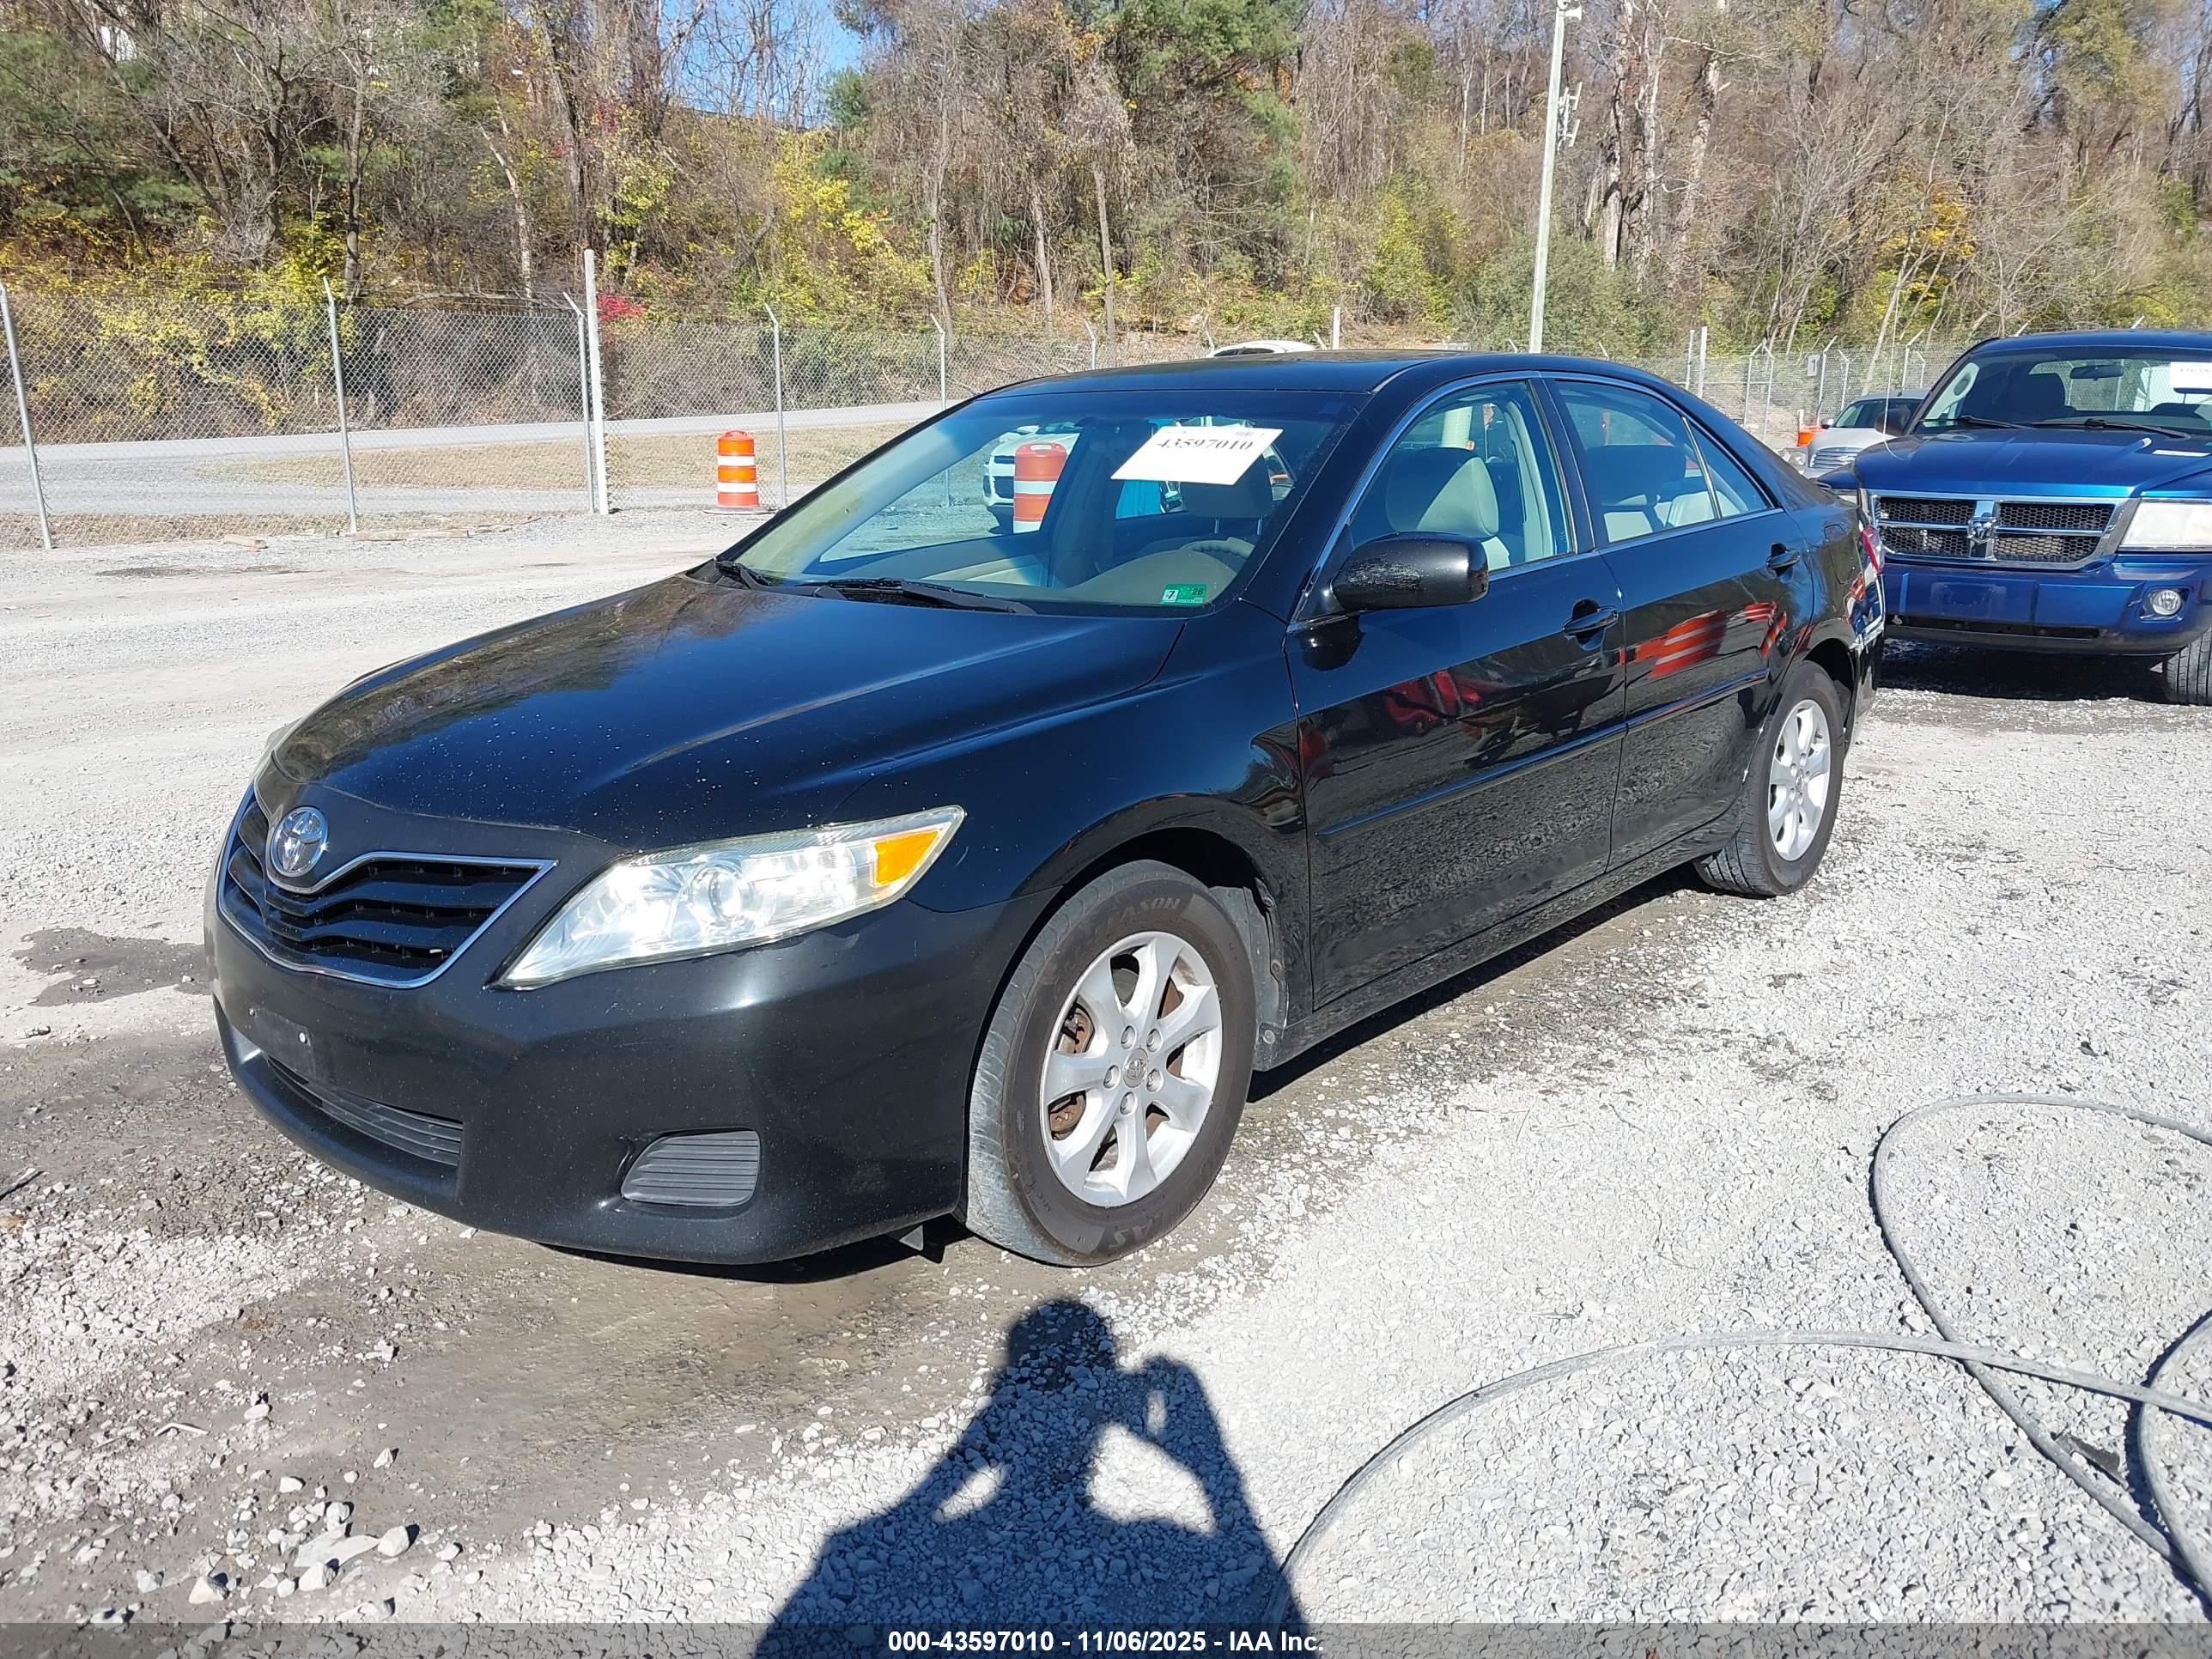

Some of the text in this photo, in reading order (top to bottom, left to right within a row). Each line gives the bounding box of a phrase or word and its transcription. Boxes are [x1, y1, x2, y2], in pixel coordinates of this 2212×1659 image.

[1157, 438, 1254, 450] 43597010
[1168, 587, 1203, 599] 7 26
